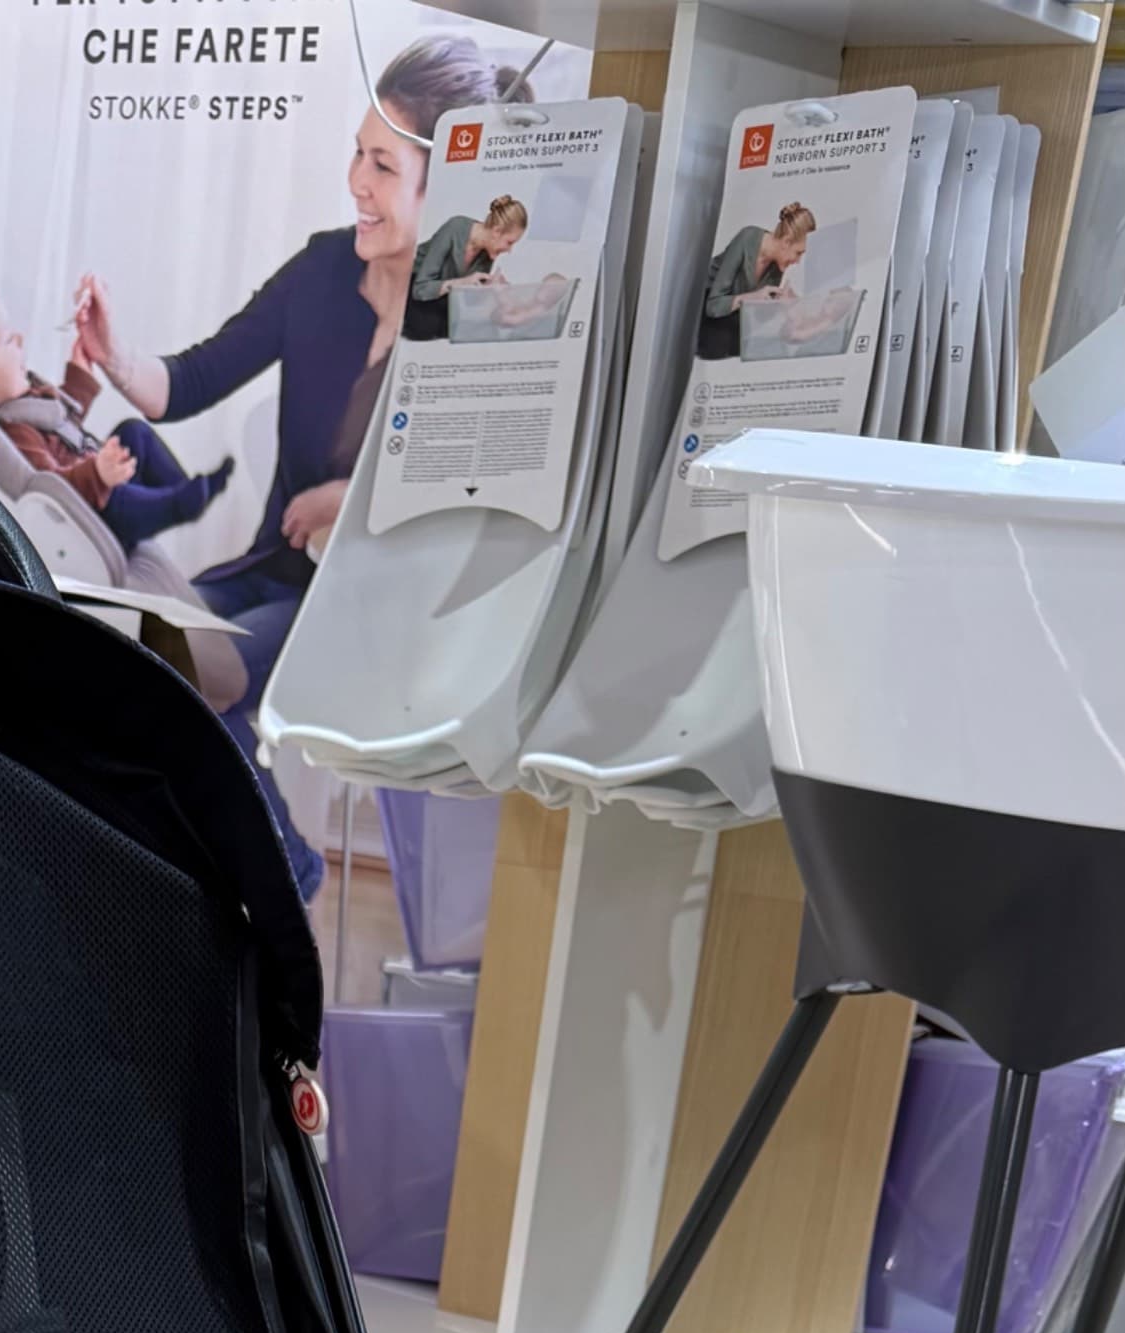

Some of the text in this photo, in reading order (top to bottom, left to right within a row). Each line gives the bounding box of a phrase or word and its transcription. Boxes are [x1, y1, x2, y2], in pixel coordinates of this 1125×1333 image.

[83, 26, 320, 64] CHE FARETE
[535, 131, 566, 144] FLEXI
[824, 131, 854, 144] FLEXI
[484, 143, 599, 160] NEWBORN SUPPORT 3
[775, 142, 887, 165] NEWBORN SUPPORT 3
